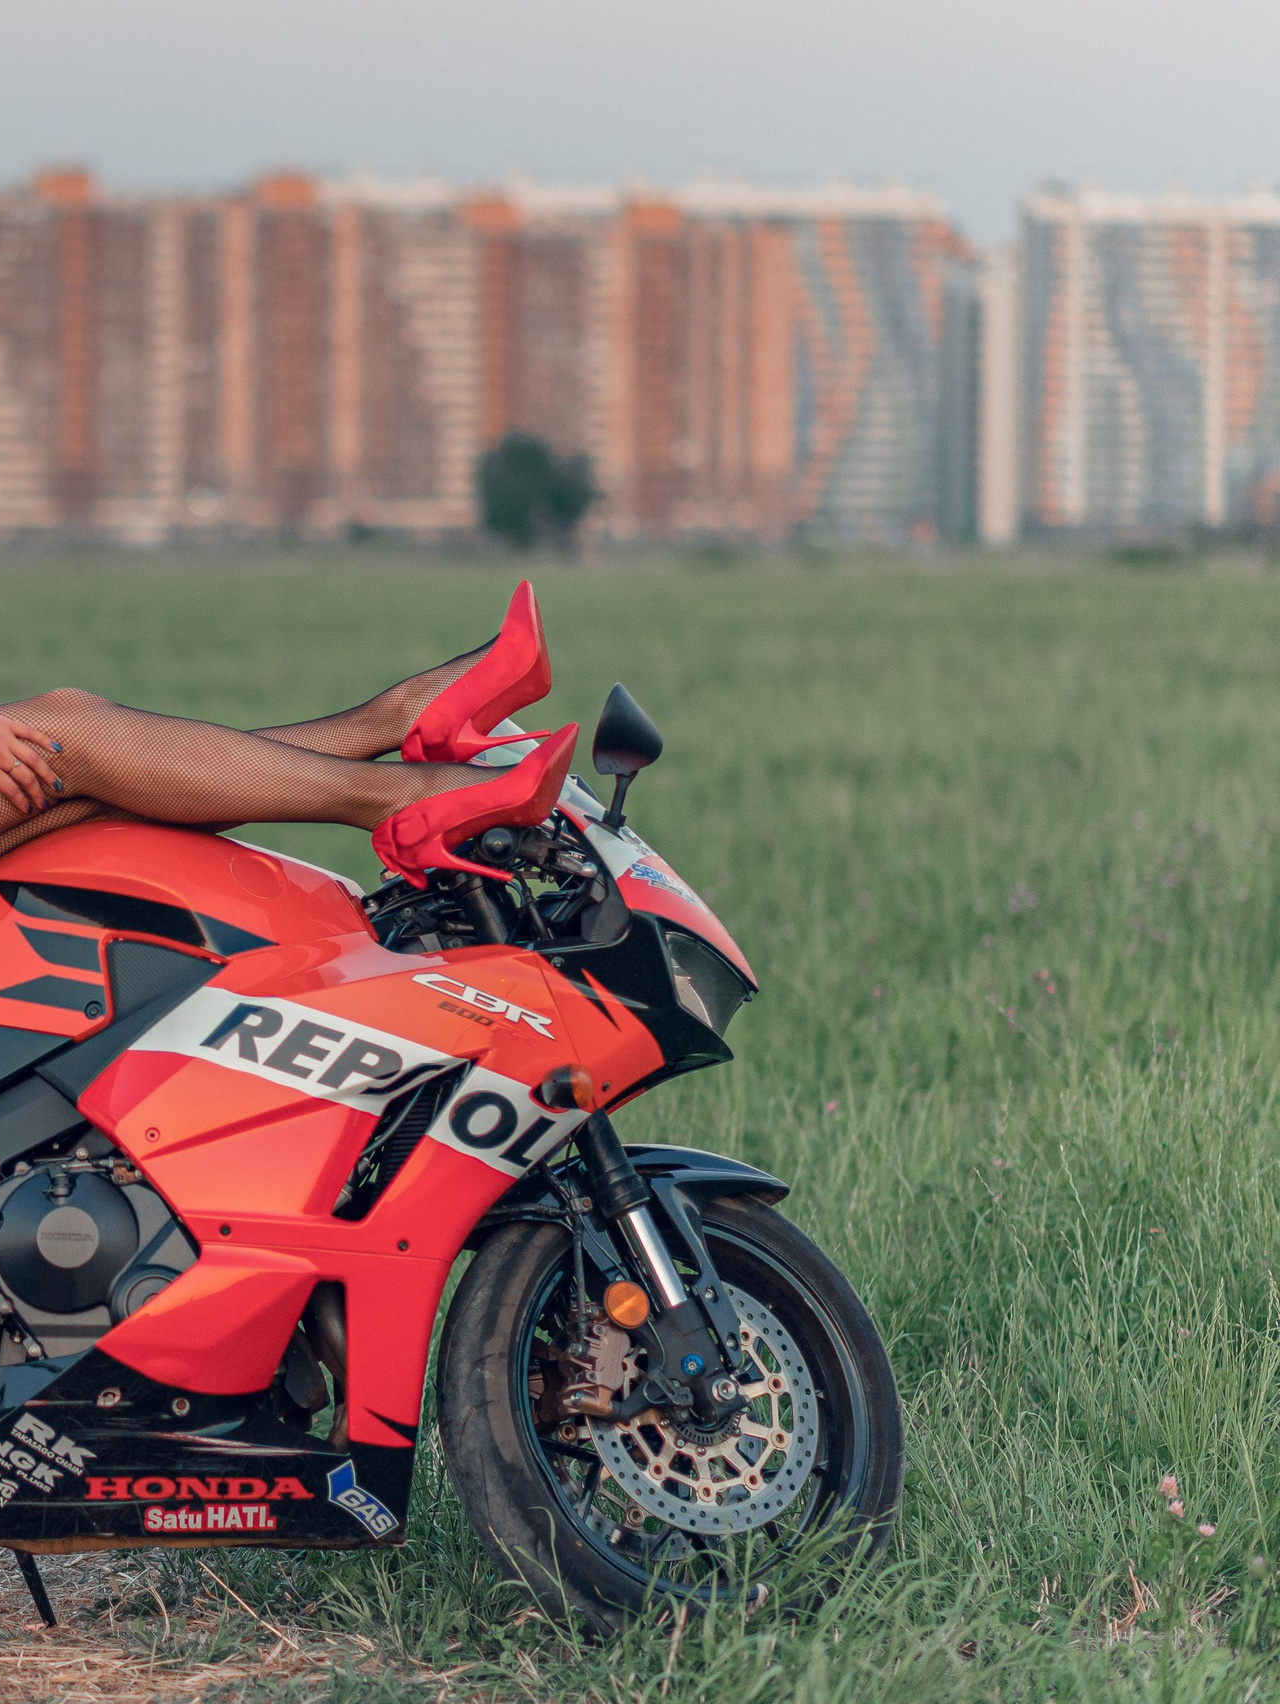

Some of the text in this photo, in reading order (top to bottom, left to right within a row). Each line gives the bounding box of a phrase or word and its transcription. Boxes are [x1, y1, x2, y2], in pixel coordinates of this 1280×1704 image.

[412, 972, 557, 1042] CBR
[10, 1428, 85, 1477] TAKASAGO CHAIN
[14, 1412, 98, 1468] RK
[16, 1469, 53, 1493] PLUGS
[84, 1476, 315, 1501] HONDA
[147, 1506, 274, 1530] Satu HATI.
[336, 1488, 393, 1534] GAS
